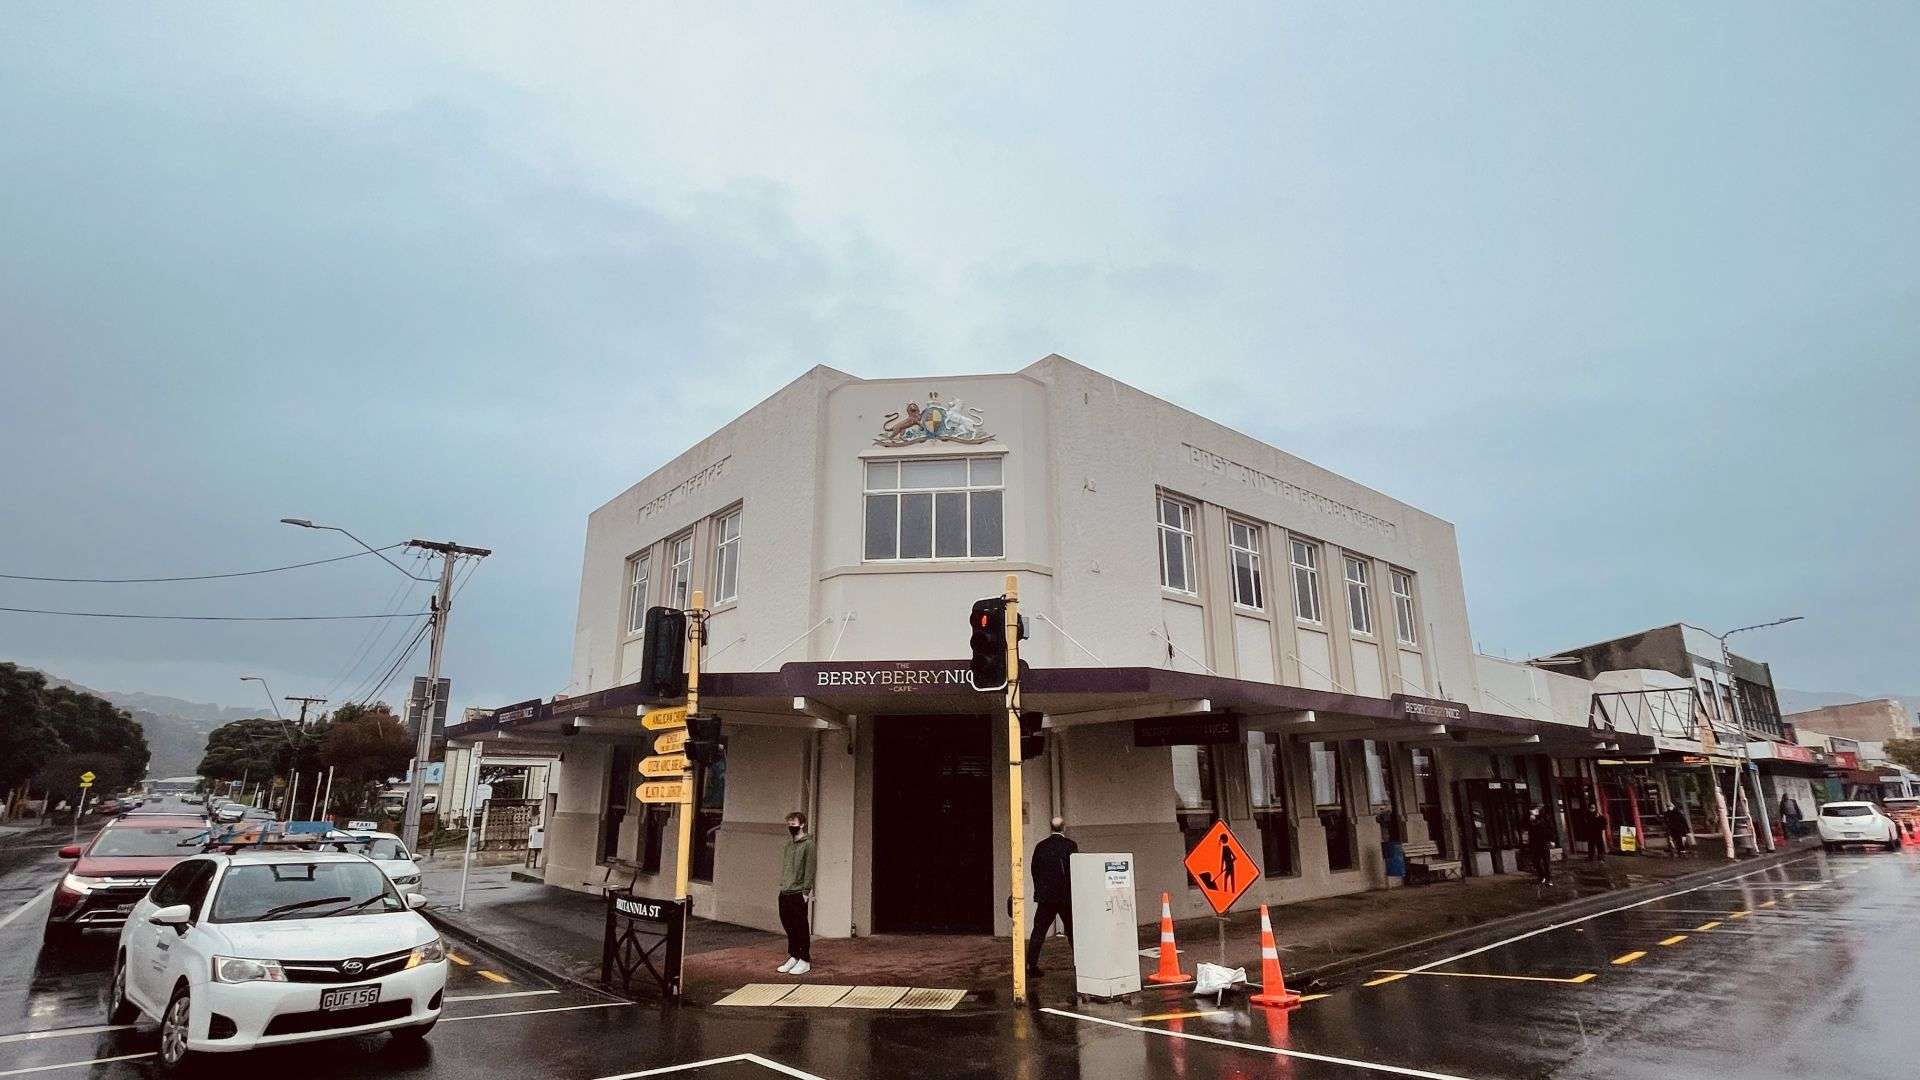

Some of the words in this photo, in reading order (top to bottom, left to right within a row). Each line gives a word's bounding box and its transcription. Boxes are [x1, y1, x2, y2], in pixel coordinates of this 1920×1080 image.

[817, 669, 973, 686] BERRYBERRYNIC
[616, 898, 648, 916] BRITANNIA
[649, 905, 661, 917] ST
[324, 989, 376, 1007] GUF156
